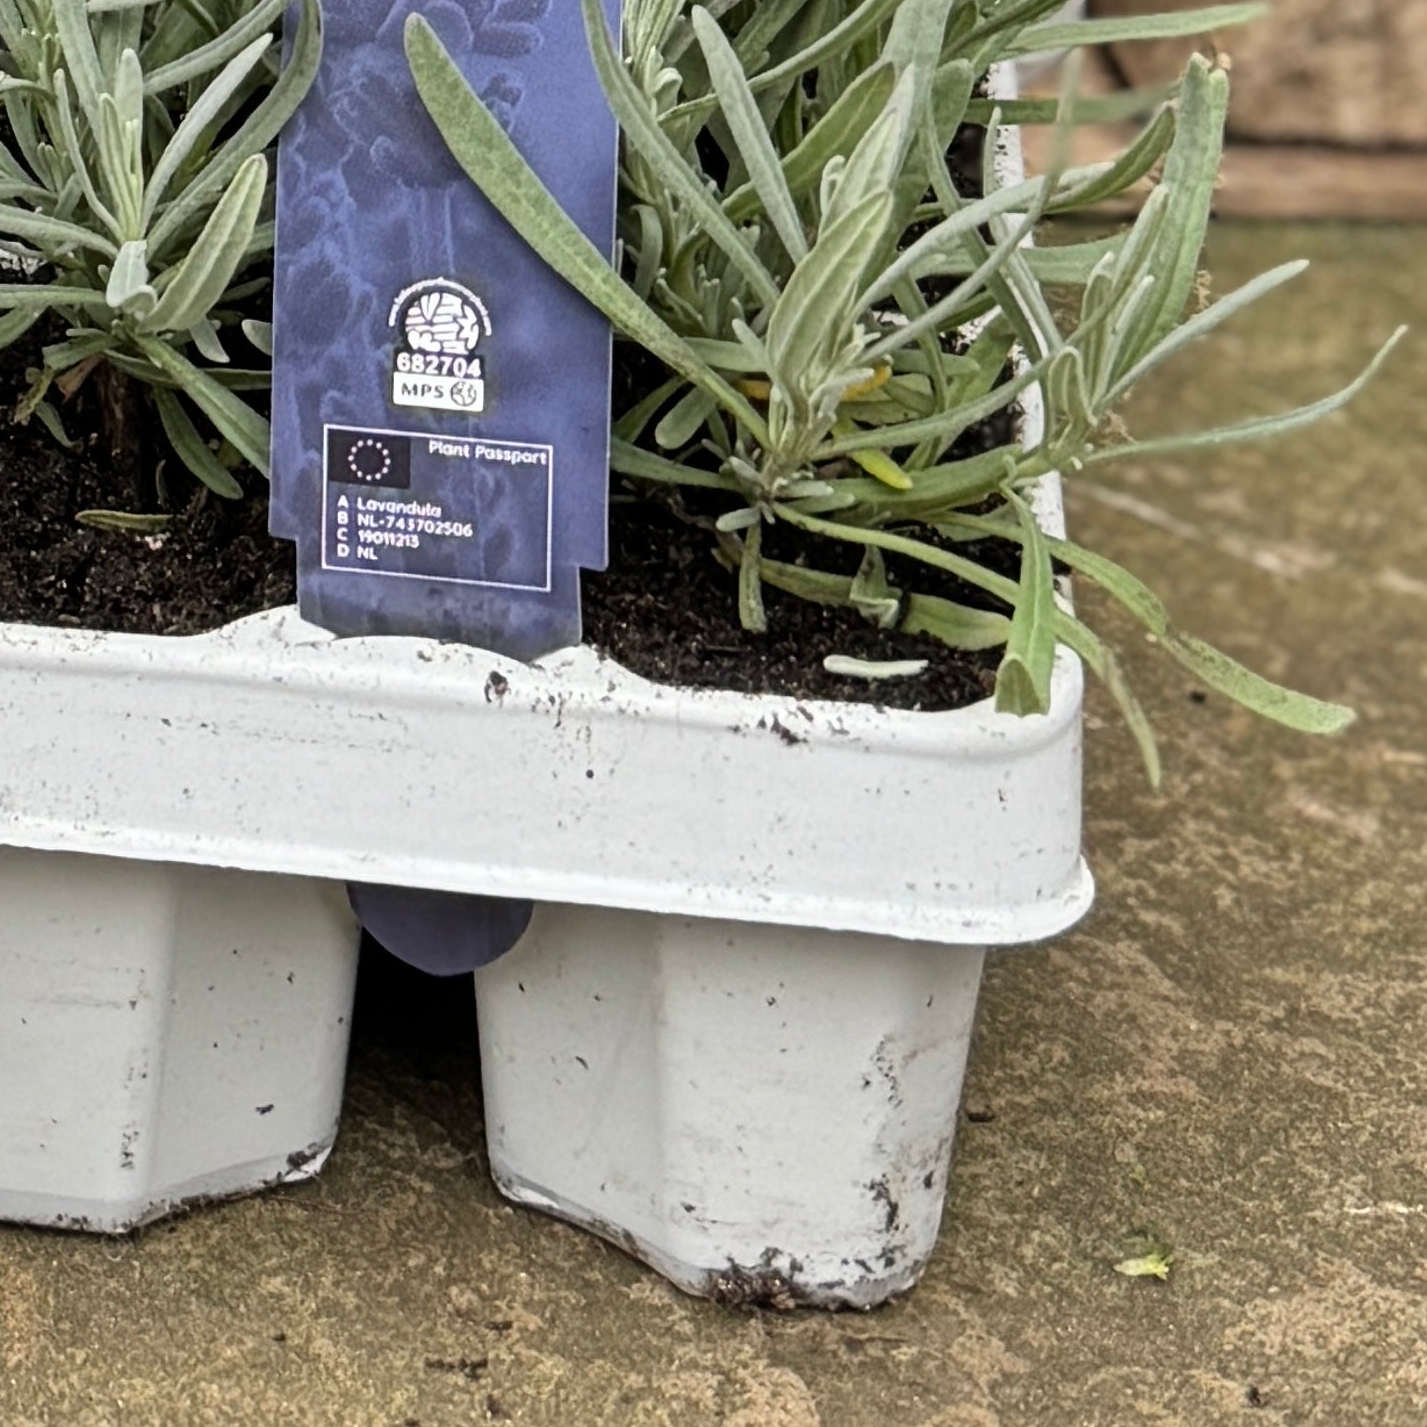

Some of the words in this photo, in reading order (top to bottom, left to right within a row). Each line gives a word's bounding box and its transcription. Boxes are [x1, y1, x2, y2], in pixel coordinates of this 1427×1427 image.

[396, 352, 481, 378] 682704
[401, 382, 444, 399] MPS
[429, 440, 470, 458] Plant
[475, 444, 547, 465] Passport
[337, 494, 349, 508] A
[357, 496, 442, 518] Lavandula
[337, 511, 348, 525] B
[337, 528, 348, 541] C
[337, 543, 350, 557] D
[357, 546, 378, 560] NL
